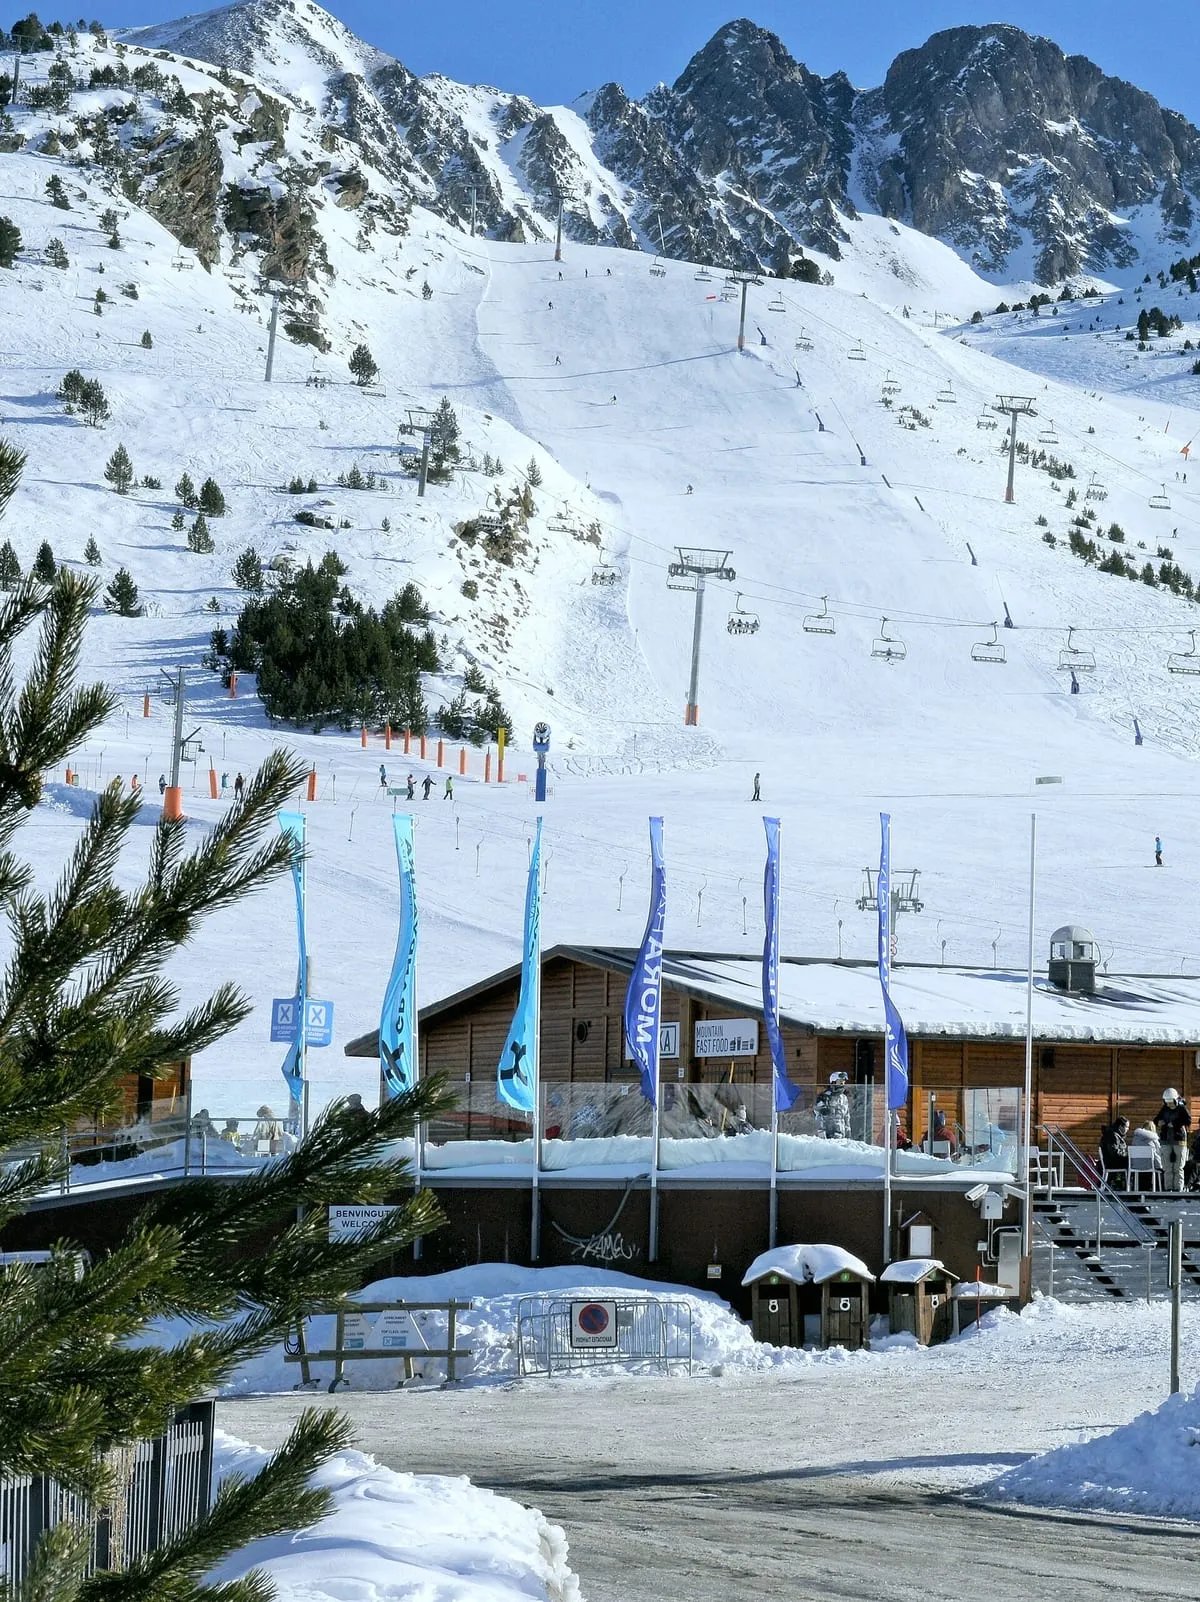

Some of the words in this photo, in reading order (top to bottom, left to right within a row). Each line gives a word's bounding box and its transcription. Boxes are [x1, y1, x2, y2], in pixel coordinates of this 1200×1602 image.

[696, 1026, 724, 1038] MOUNTAIN
[696, 1040, 711, 1053] FAST
[713, 1039, 729, 1052] FOOD
[336, 1210, 391, 1218] BENVINGUT
[342, 1220, 380, 1228] WELCO
